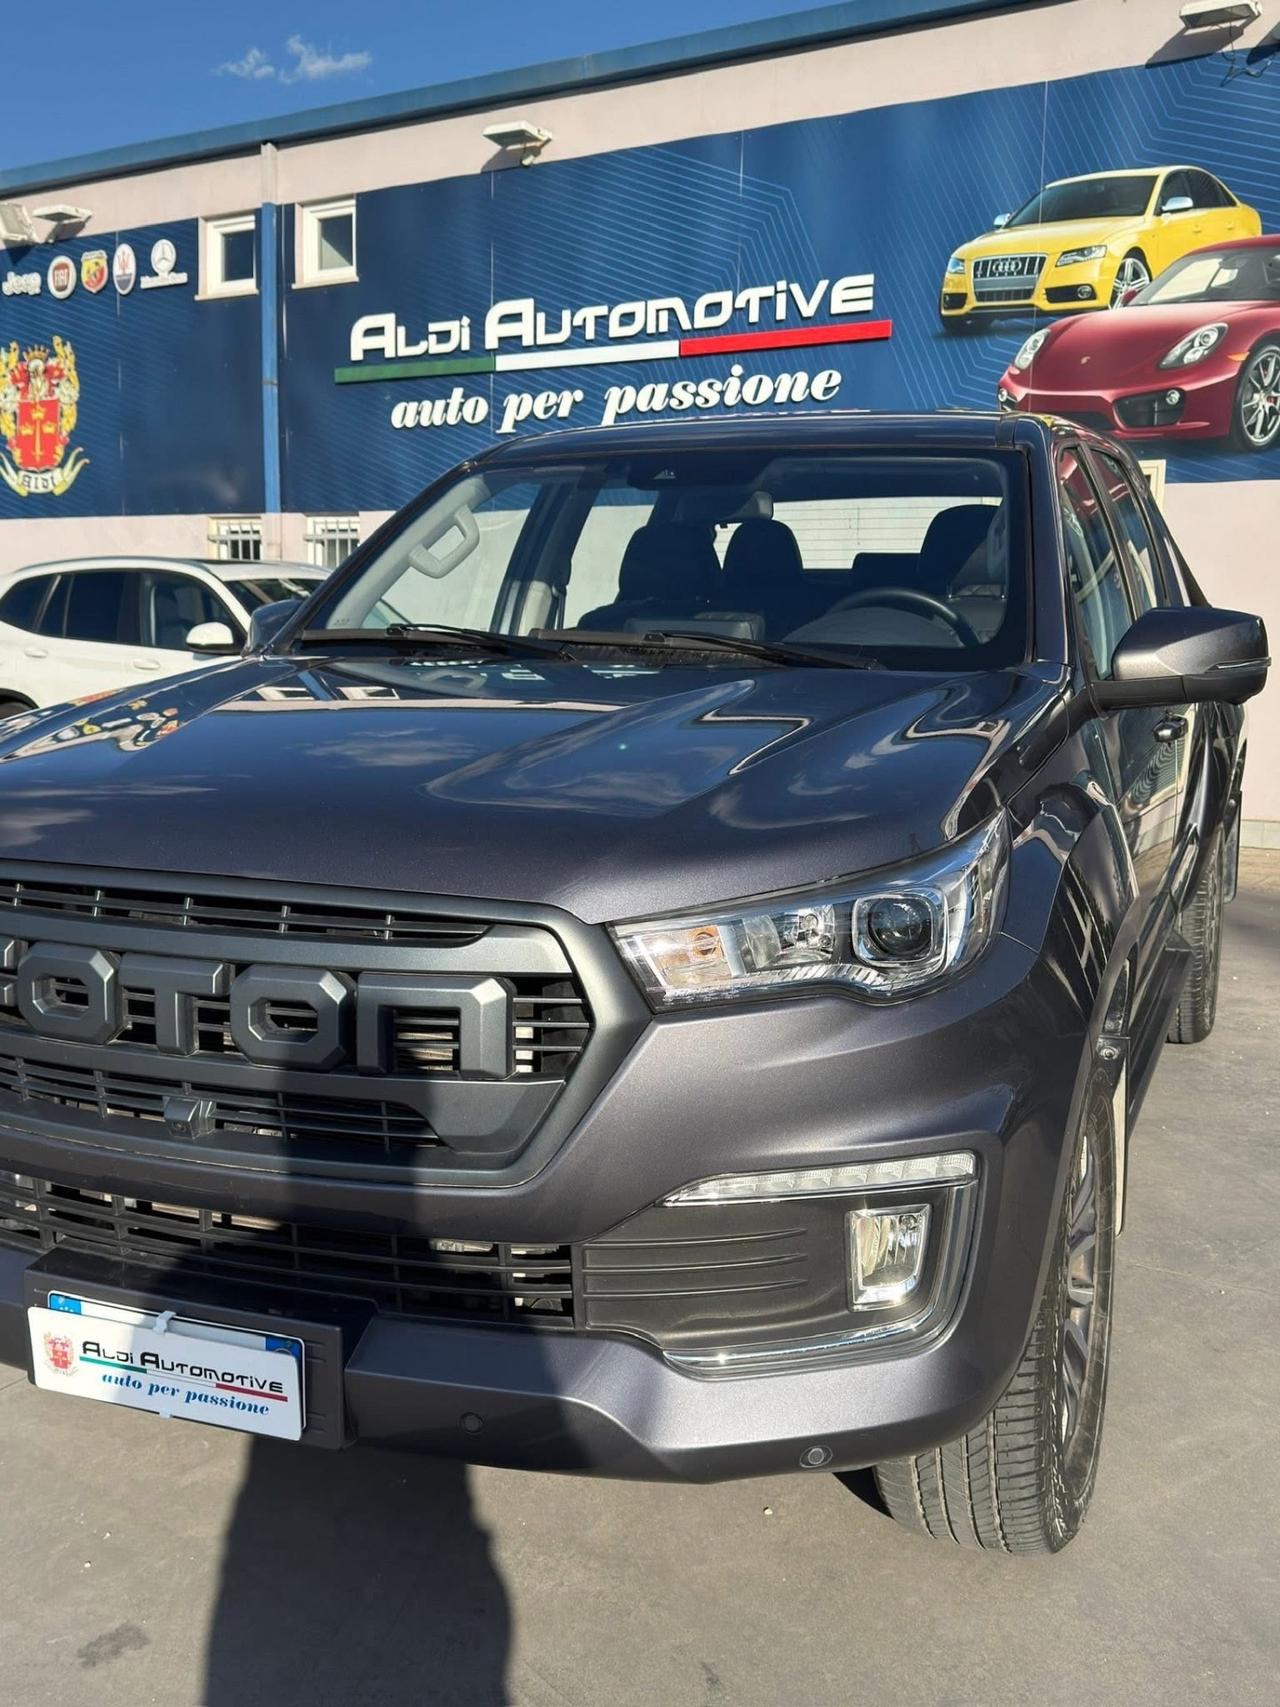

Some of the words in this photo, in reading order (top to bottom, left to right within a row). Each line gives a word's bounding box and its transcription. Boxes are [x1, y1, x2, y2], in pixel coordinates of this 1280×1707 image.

[391, 387, 488, 430] auto
[496, 384, 584, 434] per
[600, 363, 842, 426] passione
[0, 938, 516, 1081] OTON
[102, 1374, 142, 1390] auto
[147, 1382, 180, 1397] per
[184, 1388, 270, 1416] passione
